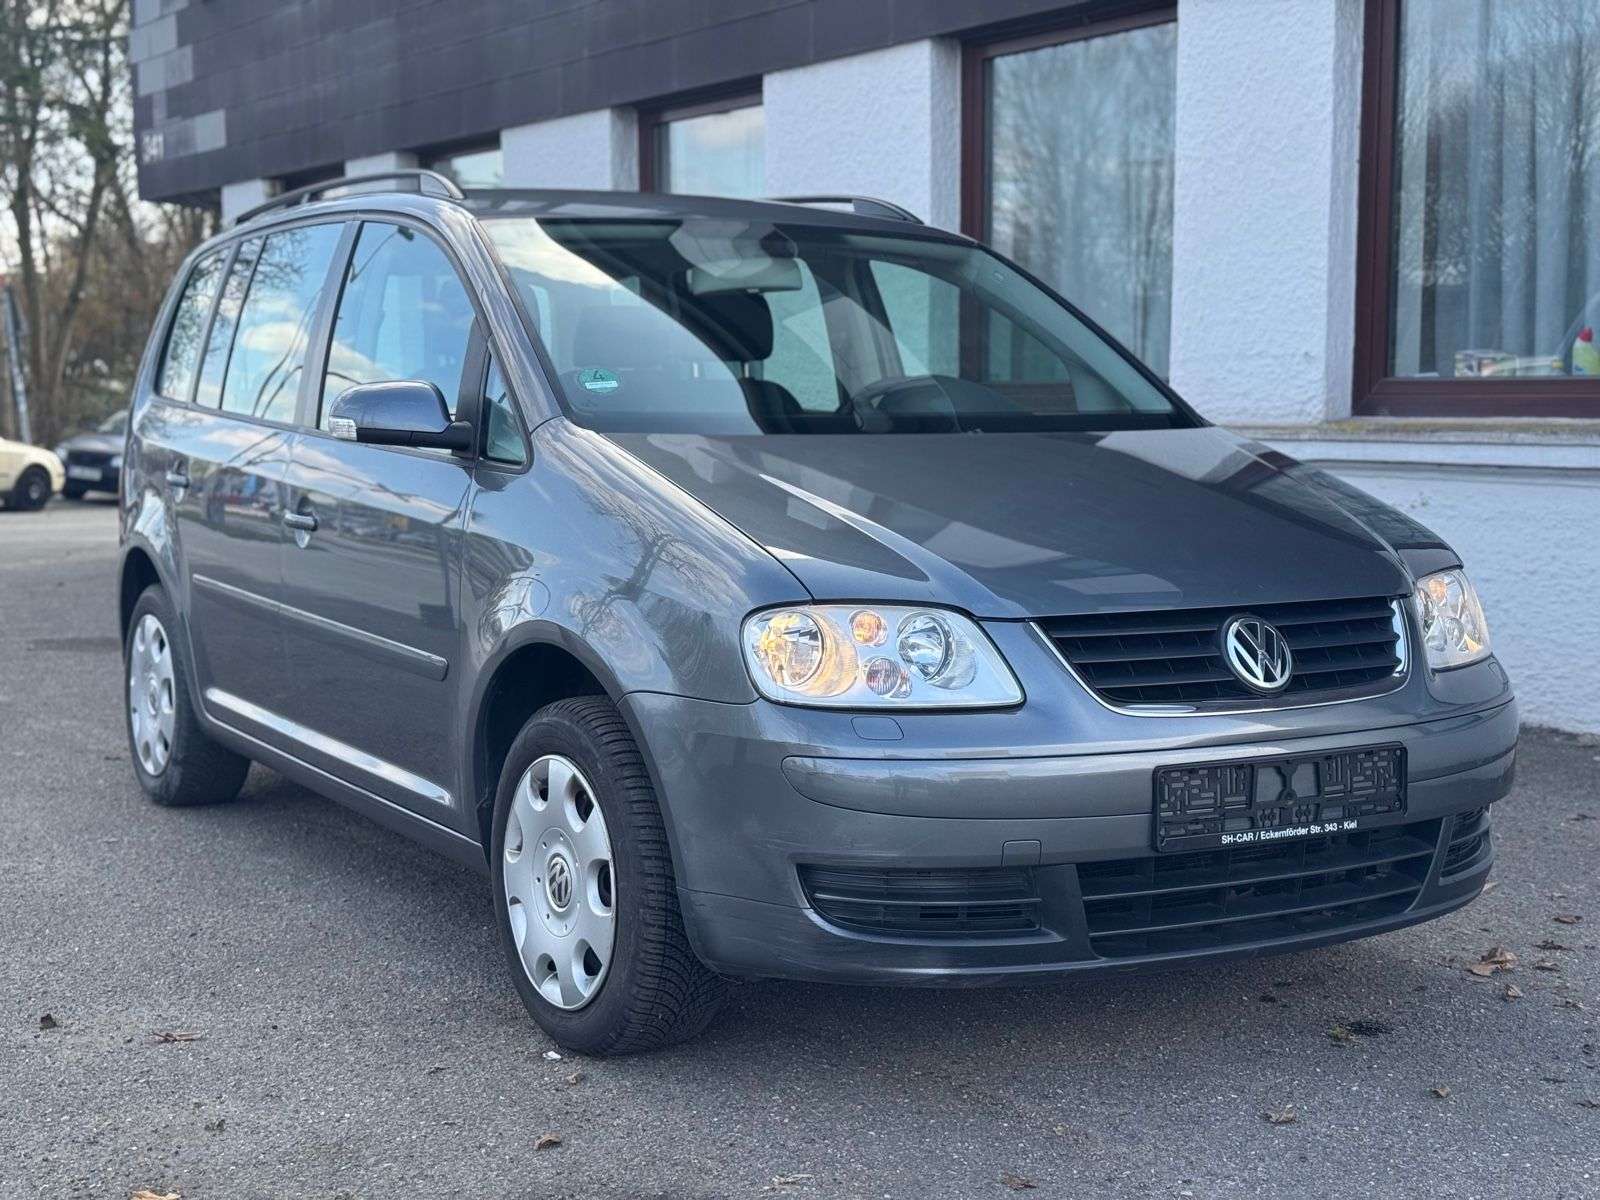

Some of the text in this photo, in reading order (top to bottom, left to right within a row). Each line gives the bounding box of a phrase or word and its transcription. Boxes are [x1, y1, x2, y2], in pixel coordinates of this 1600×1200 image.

[1226, 617, 1292, 688] VW
[1221, 832, 1254, 844] SH-CAR
[1260, 827, 1309, 840] Eckernförder
[1310, 824, 1324, 834] Str.
[1324, 822, 1338, 832] 343
[1343, 819, 1358, 830] Kiel
